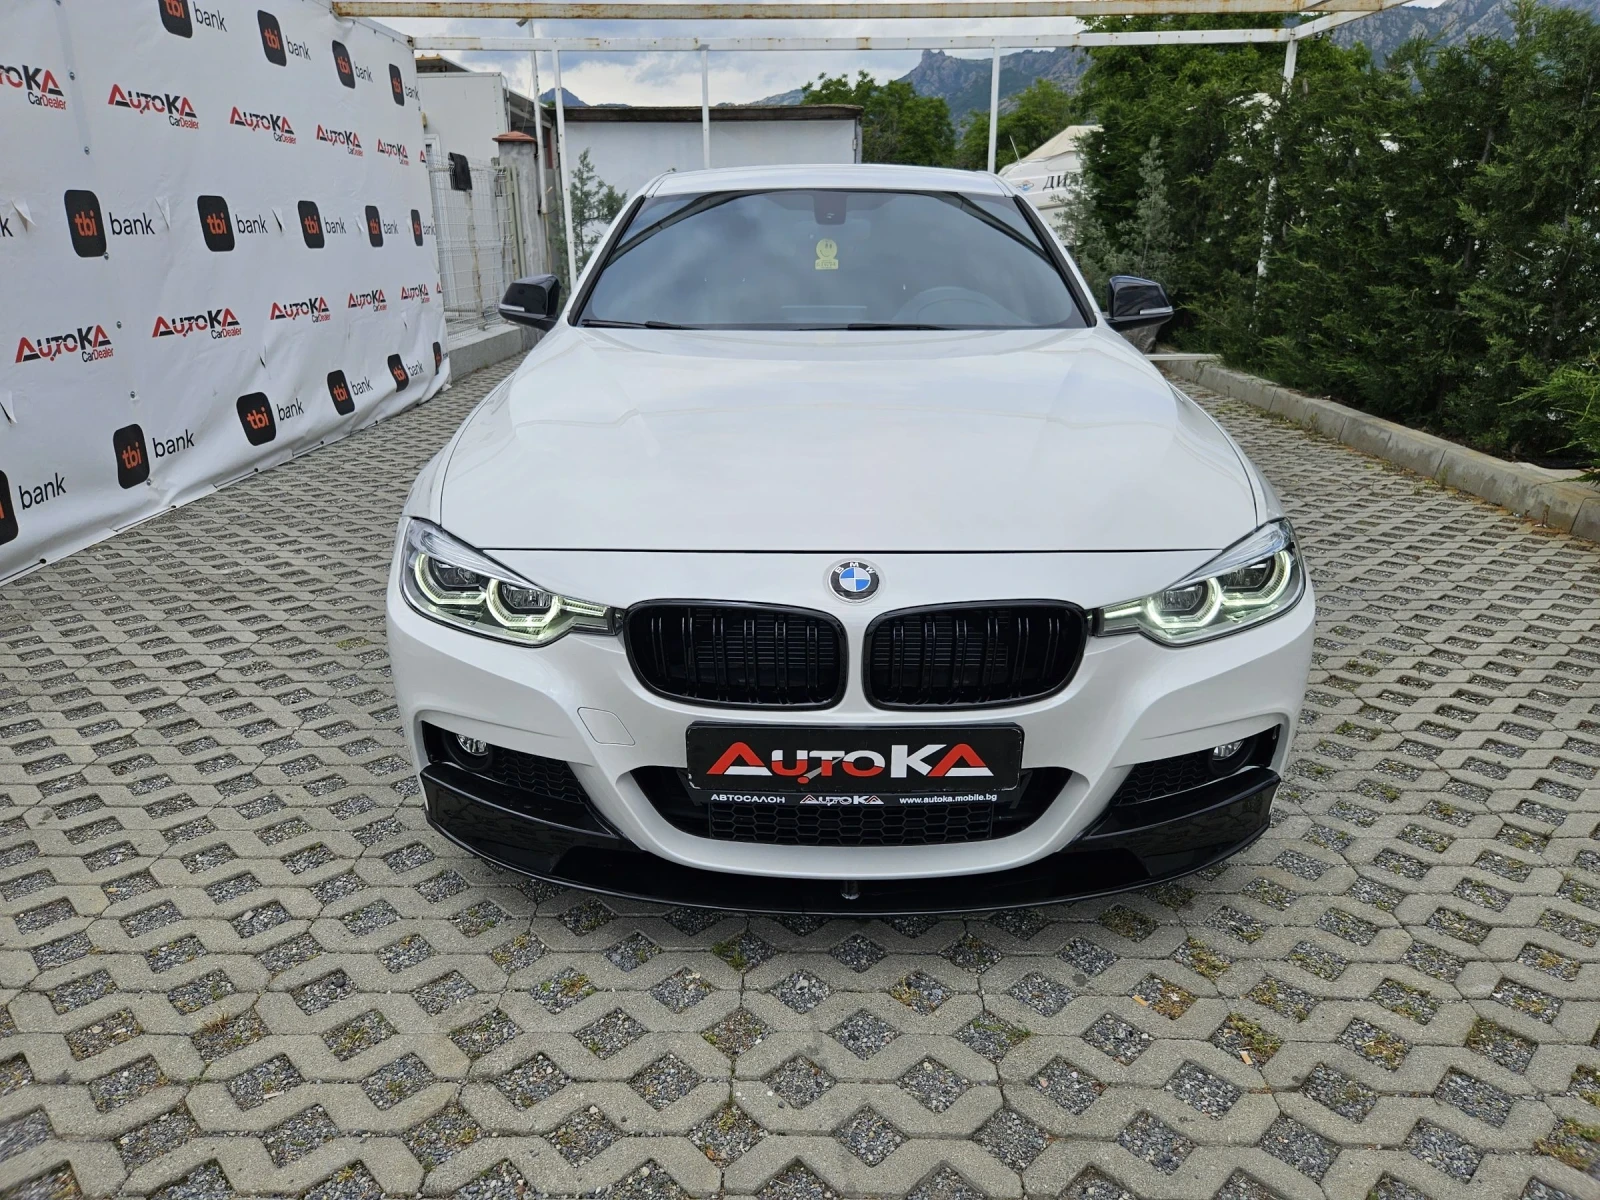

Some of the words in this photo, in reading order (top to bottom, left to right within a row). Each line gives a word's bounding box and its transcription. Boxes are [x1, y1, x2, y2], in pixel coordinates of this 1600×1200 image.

[193, 1, 228, 32] bank
[264, 29, 280, 50] tbi
[285, 35, 311, 60] bank
[337, 52, 351, 74] tbi
[354, 61, 374, 83] bank
[27, 91, 66, 110] CarDealer
[75, 210, 97, 236] tbi
[109, 212, 156, 236] bank
[206, 212, 227, 235] tbi
[235, 214, 269, 235] bank
[304, 215, 319, 234] tbi
[323, 217, 347, 235] bank
[382, 219, 399, 235] bank
[211, 327, 242, 340] CarDealer
[81, 347, 114, 363] CarDealer
[333, 382, 349, 402] tbi
[350, 376, 374, 396] bank
[246, 407, 270, 430] tbi
[277, 398, 305, 422] bank
[122, 442, 142, 469] tbi
[152, 429, 195, 458] bank
[18, 472, 67, 510] bank
[834, 561, 876, 574] BMW
[710, 793, 786, 804] АВТОСАЛОН
[899, 792, 998, 804] www.autoka.mobile.bg
